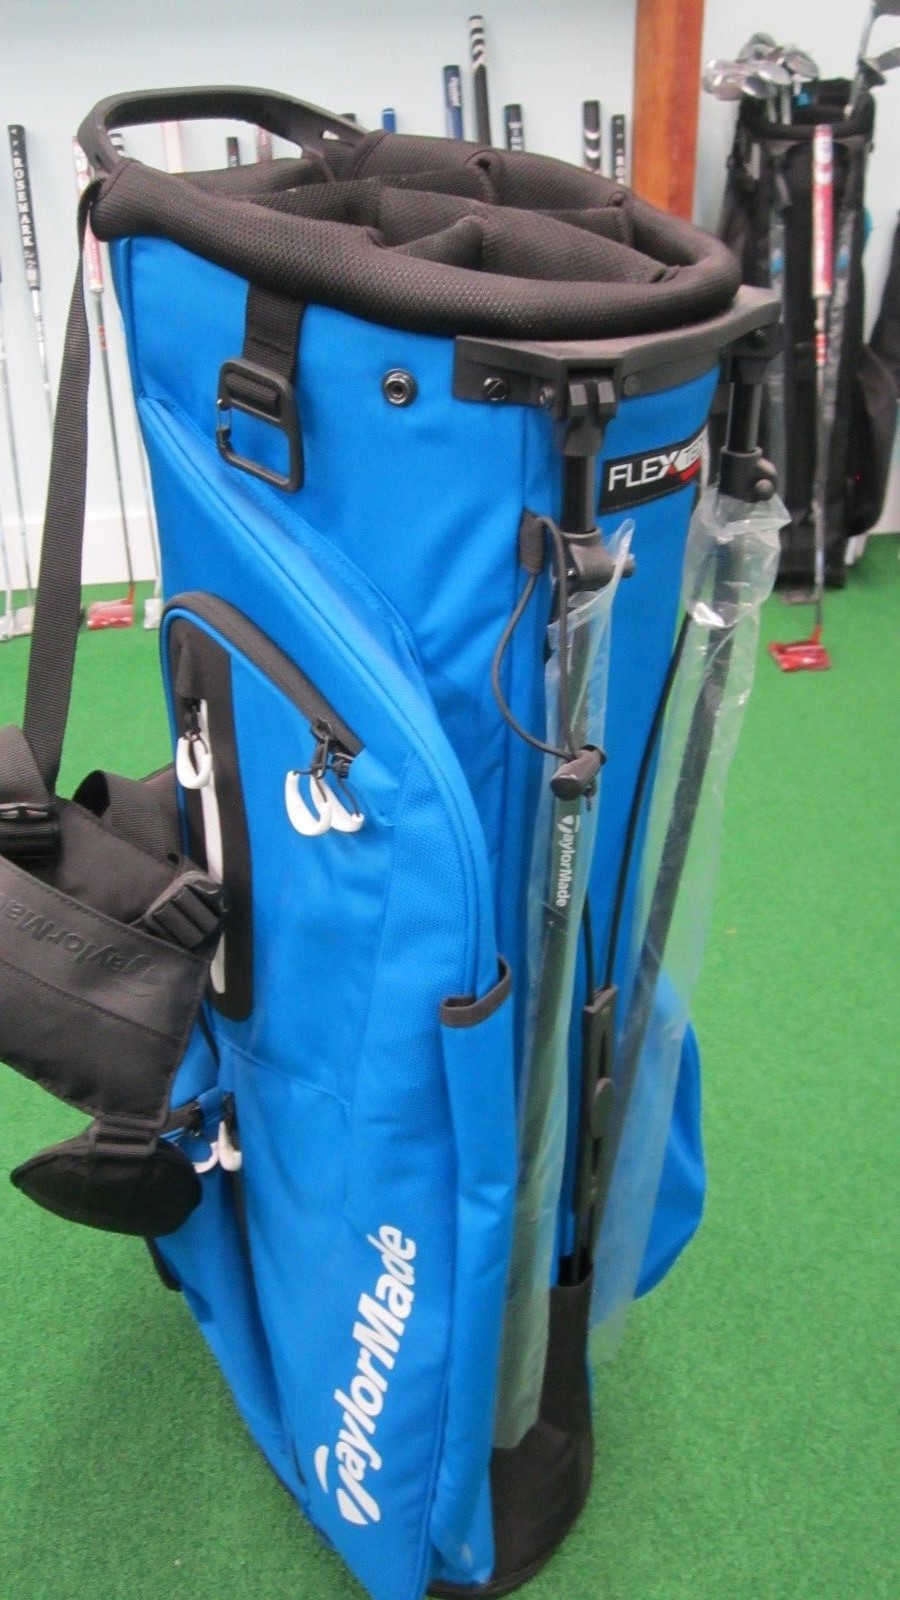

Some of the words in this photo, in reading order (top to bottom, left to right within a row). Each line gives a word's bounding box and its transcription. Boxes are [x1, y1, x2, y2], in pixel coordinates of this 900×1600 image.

[13, 157, 34, 247] ROSEMARK
[555, 814, 580, 907] TaylorMade
[0, 891, 158, 992] TaylorMa
[314, 1224, 417, 1526] TaylorMade
